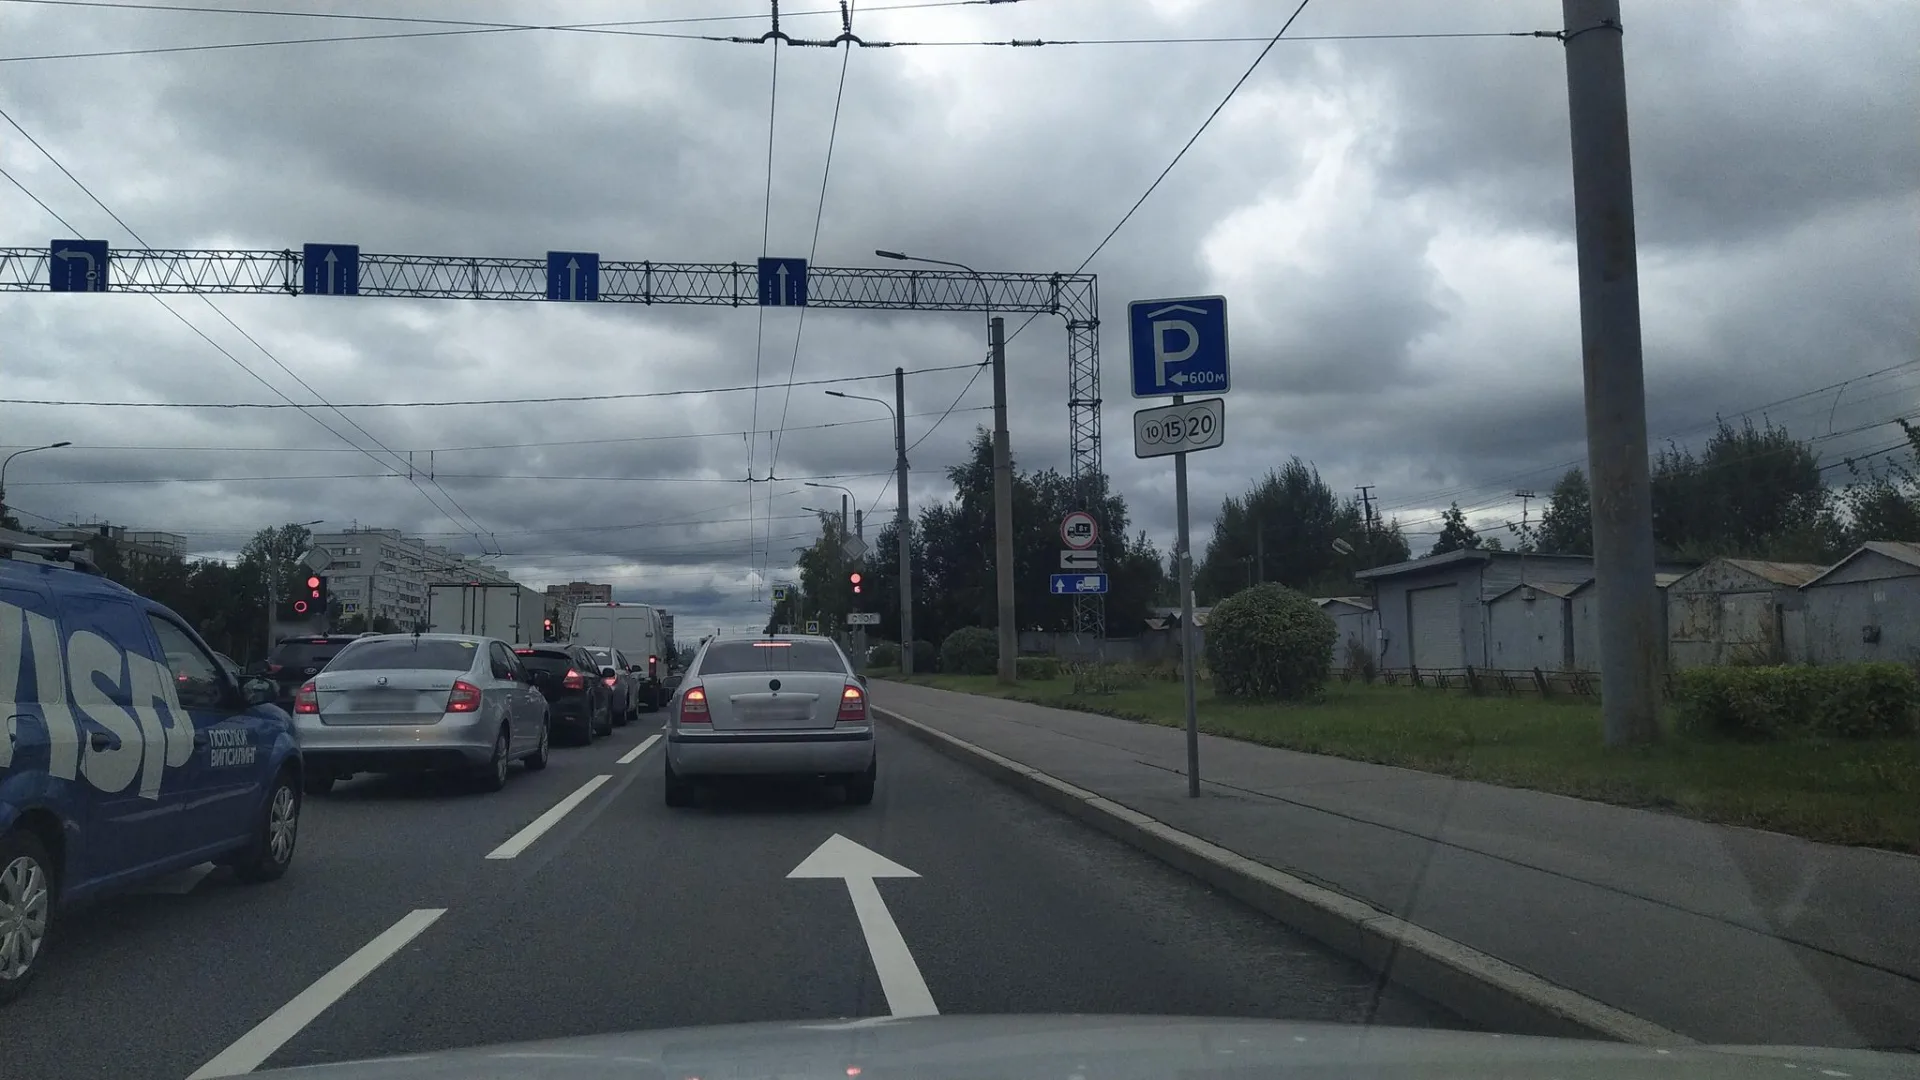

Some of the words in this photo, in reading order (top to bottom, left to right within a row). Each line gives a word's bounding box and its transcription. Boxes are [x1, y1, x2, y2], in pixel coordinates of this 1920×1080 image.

[1153, 320, 1199, 387] P
[1146, 425, 1159, 438] 10
[1164, 421, 1181, 438] 15
[1188, 415, 1212, 437] 20
